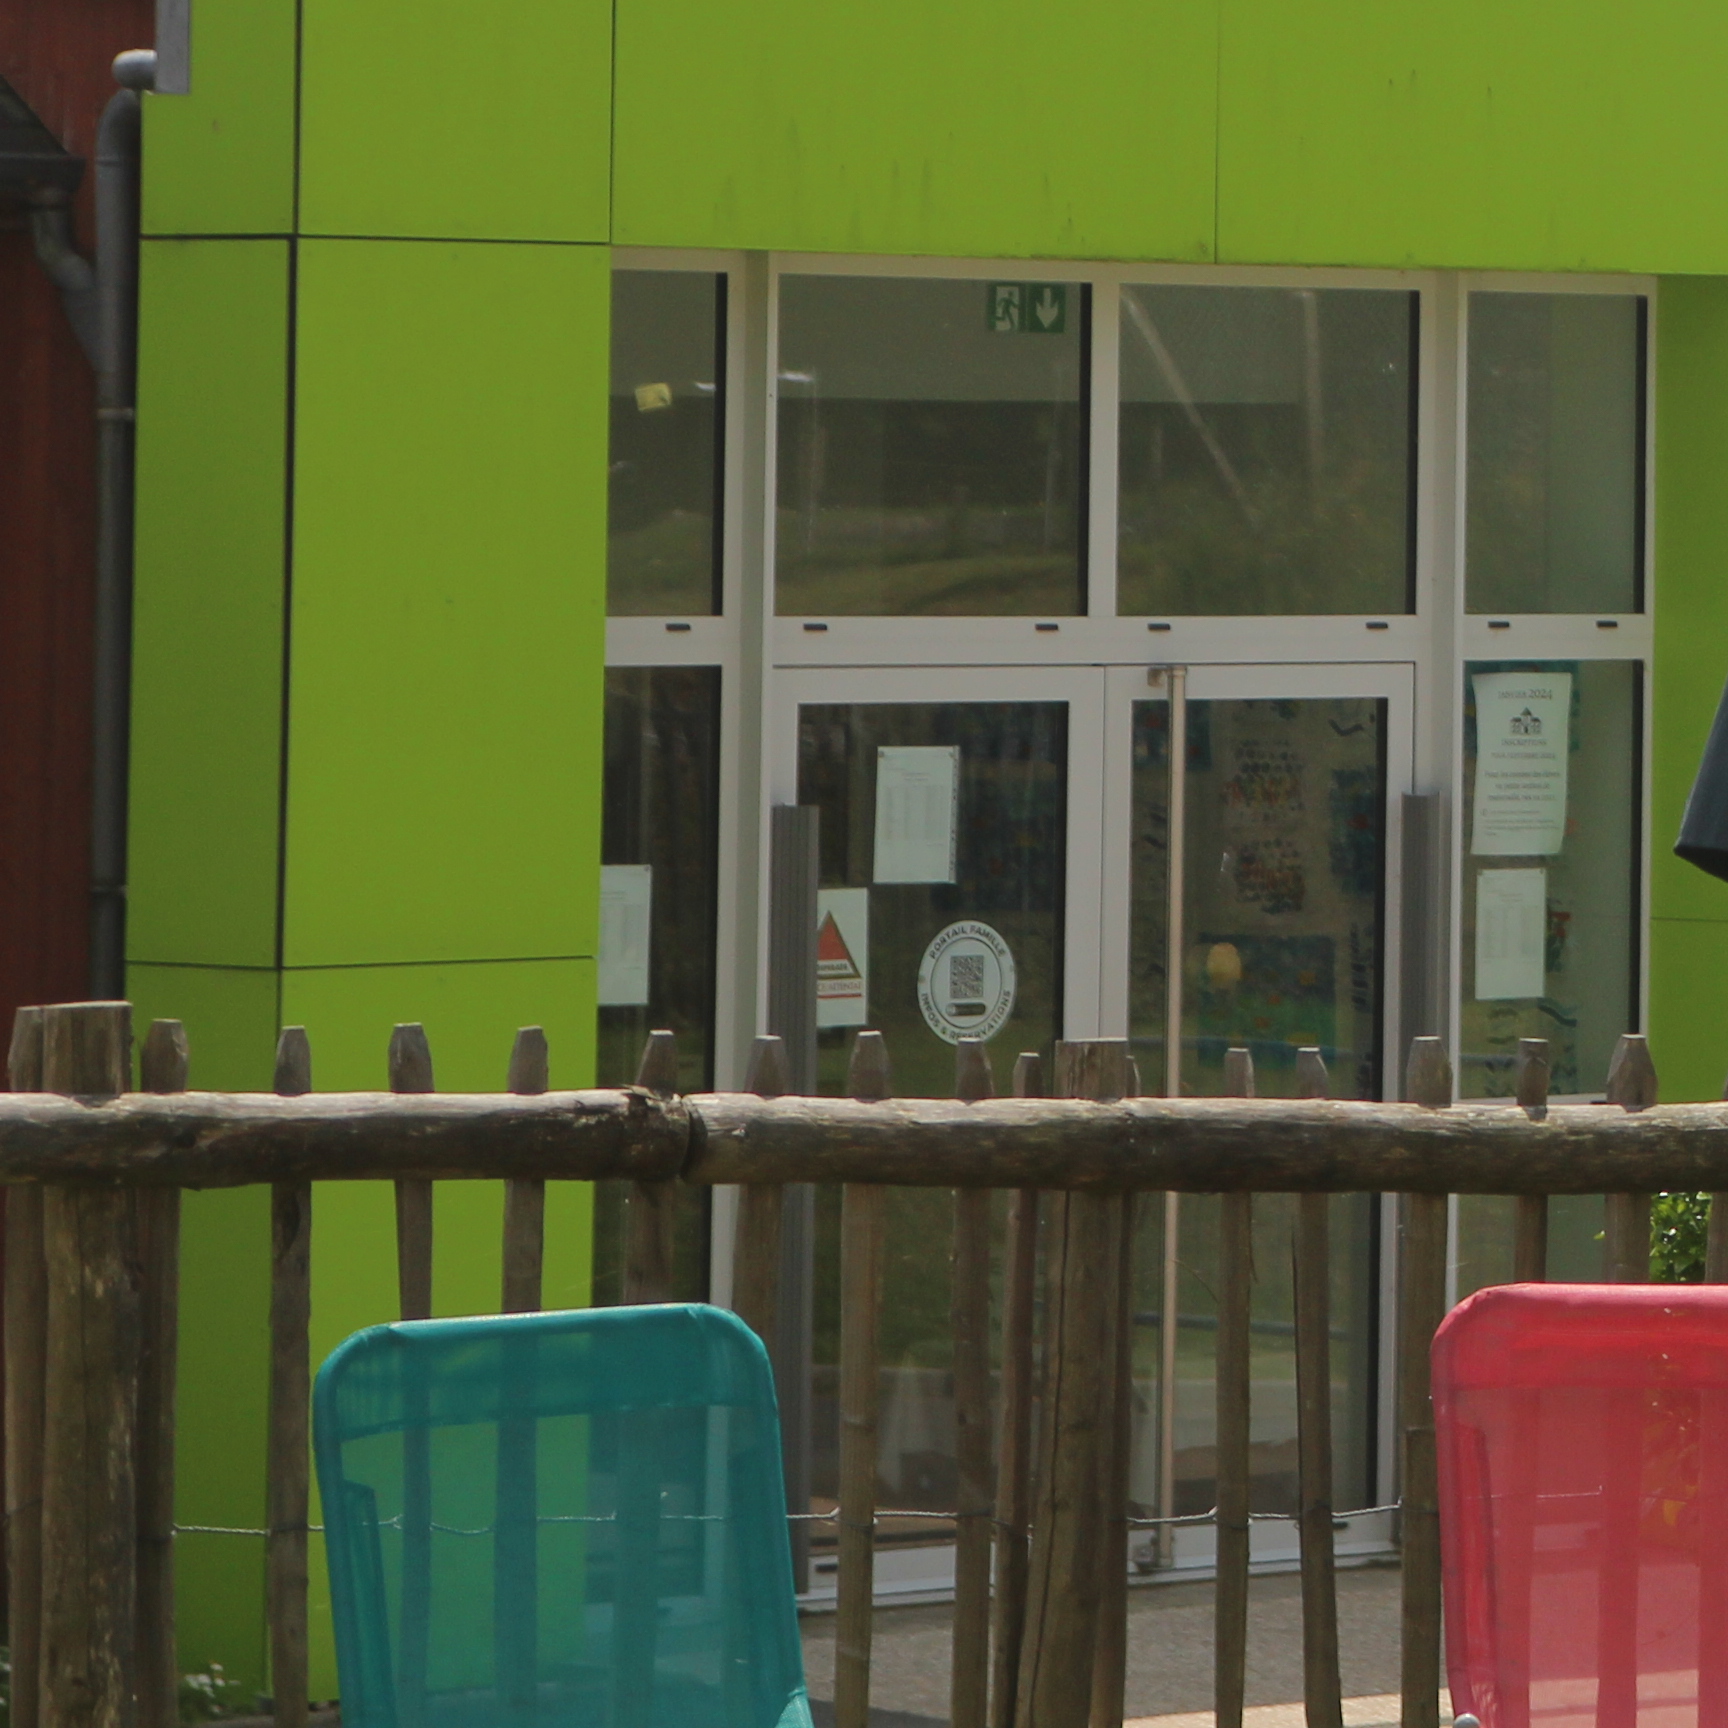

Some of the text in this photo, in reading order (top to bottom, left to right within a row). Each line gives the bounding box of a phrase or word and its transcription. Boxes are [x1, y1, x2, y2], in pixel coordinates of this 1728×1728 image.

[1529, 688, 1552, 700] 2024
[929, 925, 1006, 959] PORTAIL FAMILLE
[920, 992, 941, 1027] INFOS
